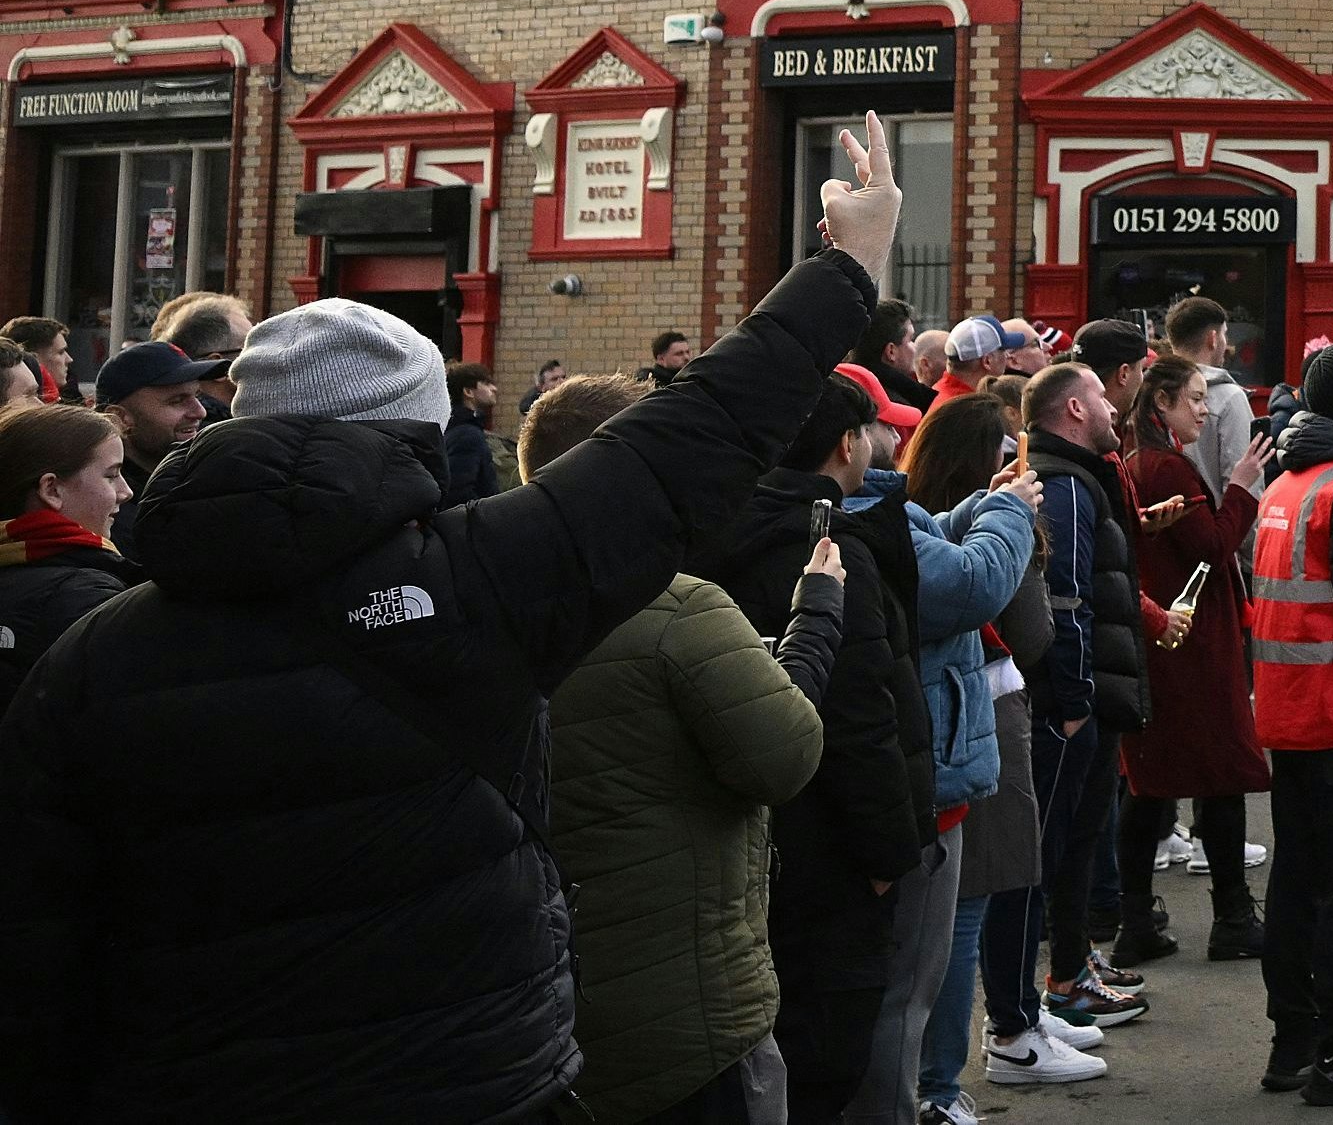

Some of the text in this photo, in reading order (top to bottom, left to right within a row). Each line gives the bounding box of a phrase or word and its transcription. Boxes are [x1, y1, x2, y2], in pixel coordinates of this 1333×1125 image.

[773, 45, 938, 77] BED & BREAKFAST
[19, 88, 139, 118] FREE FUNCTION ROOM
[585, 161, 632, 176] HOTEL
[1113, 208, 1280, 233] 0151 294 5800
[369, 586, 401, 603] THE
[347, 598, 403, 623] NORTH
[365, 610, 405, 630] FACE
